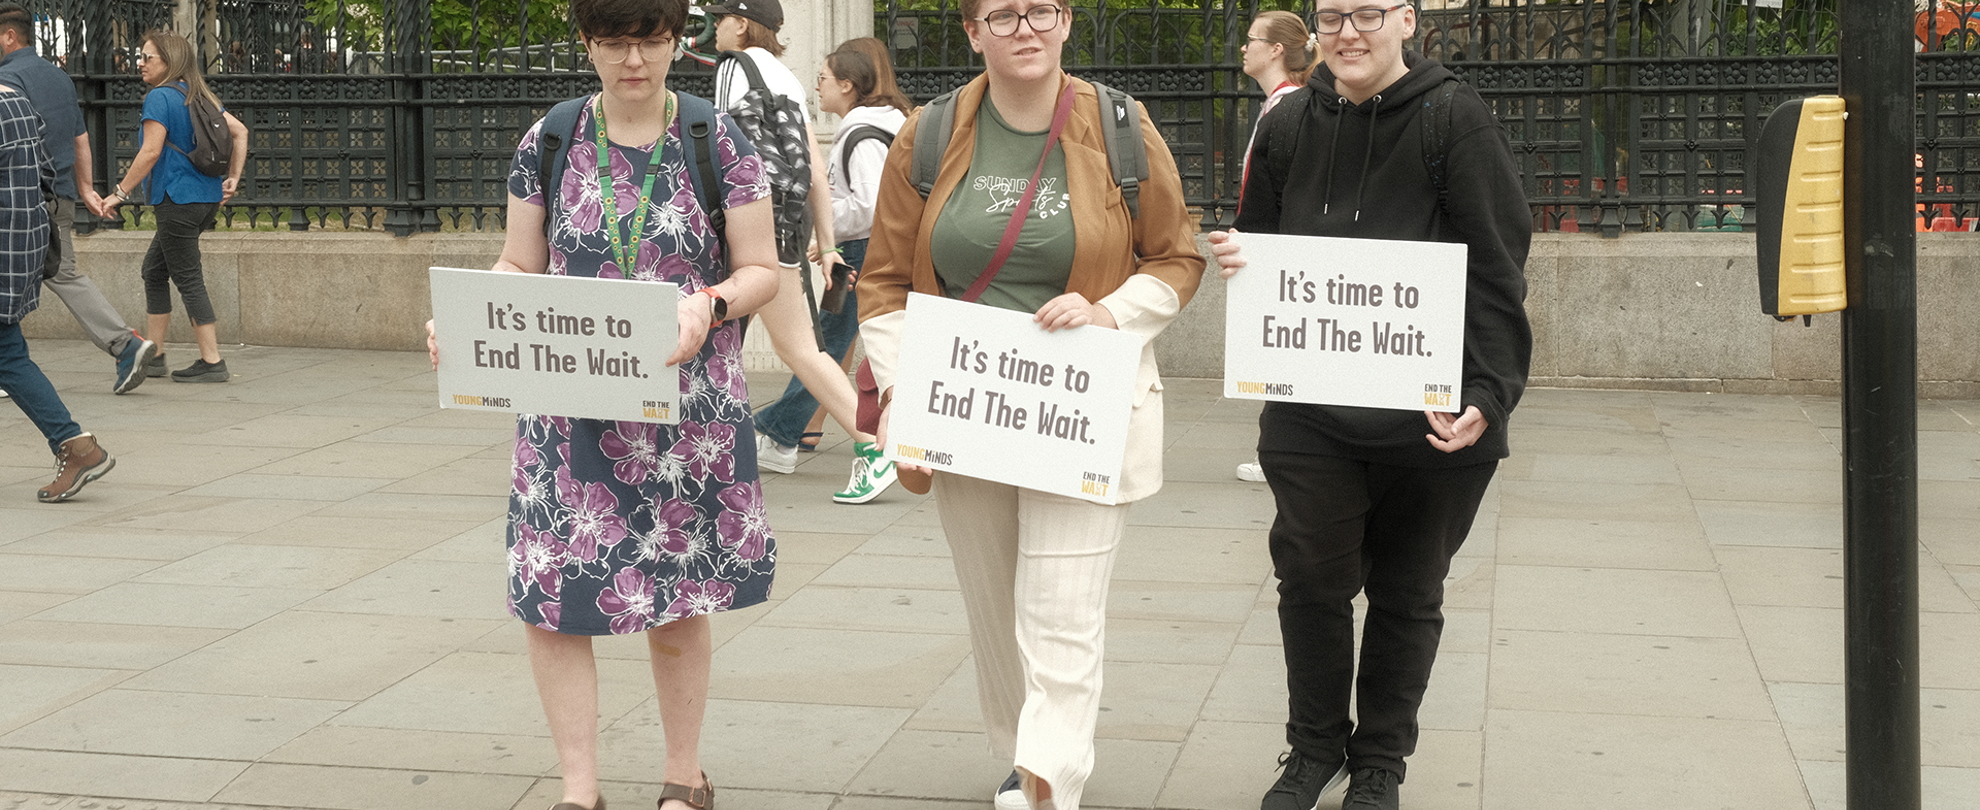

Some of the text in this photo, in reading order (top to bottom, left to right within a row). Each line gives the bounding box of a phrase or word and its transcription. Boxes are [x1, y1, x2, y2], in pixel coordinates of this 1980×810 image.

[986, 183, 1055, 212] Spts
[1279, 269, 1419, 309] It’s time to
[487, 301, 632, 339] It’s time to
[1262, 315, 1433, 358] End The Wait.
[473, 339, 649, 379] End The Wait.
[950, 335, 1090, 394] It’s time to
[642, 400, 670, 409] END THE
[1424, 383, 1452, 394] END THE
[927, 380, 1096, 445] End The Wait.
[1083, 471, 1110, 485] END THE
